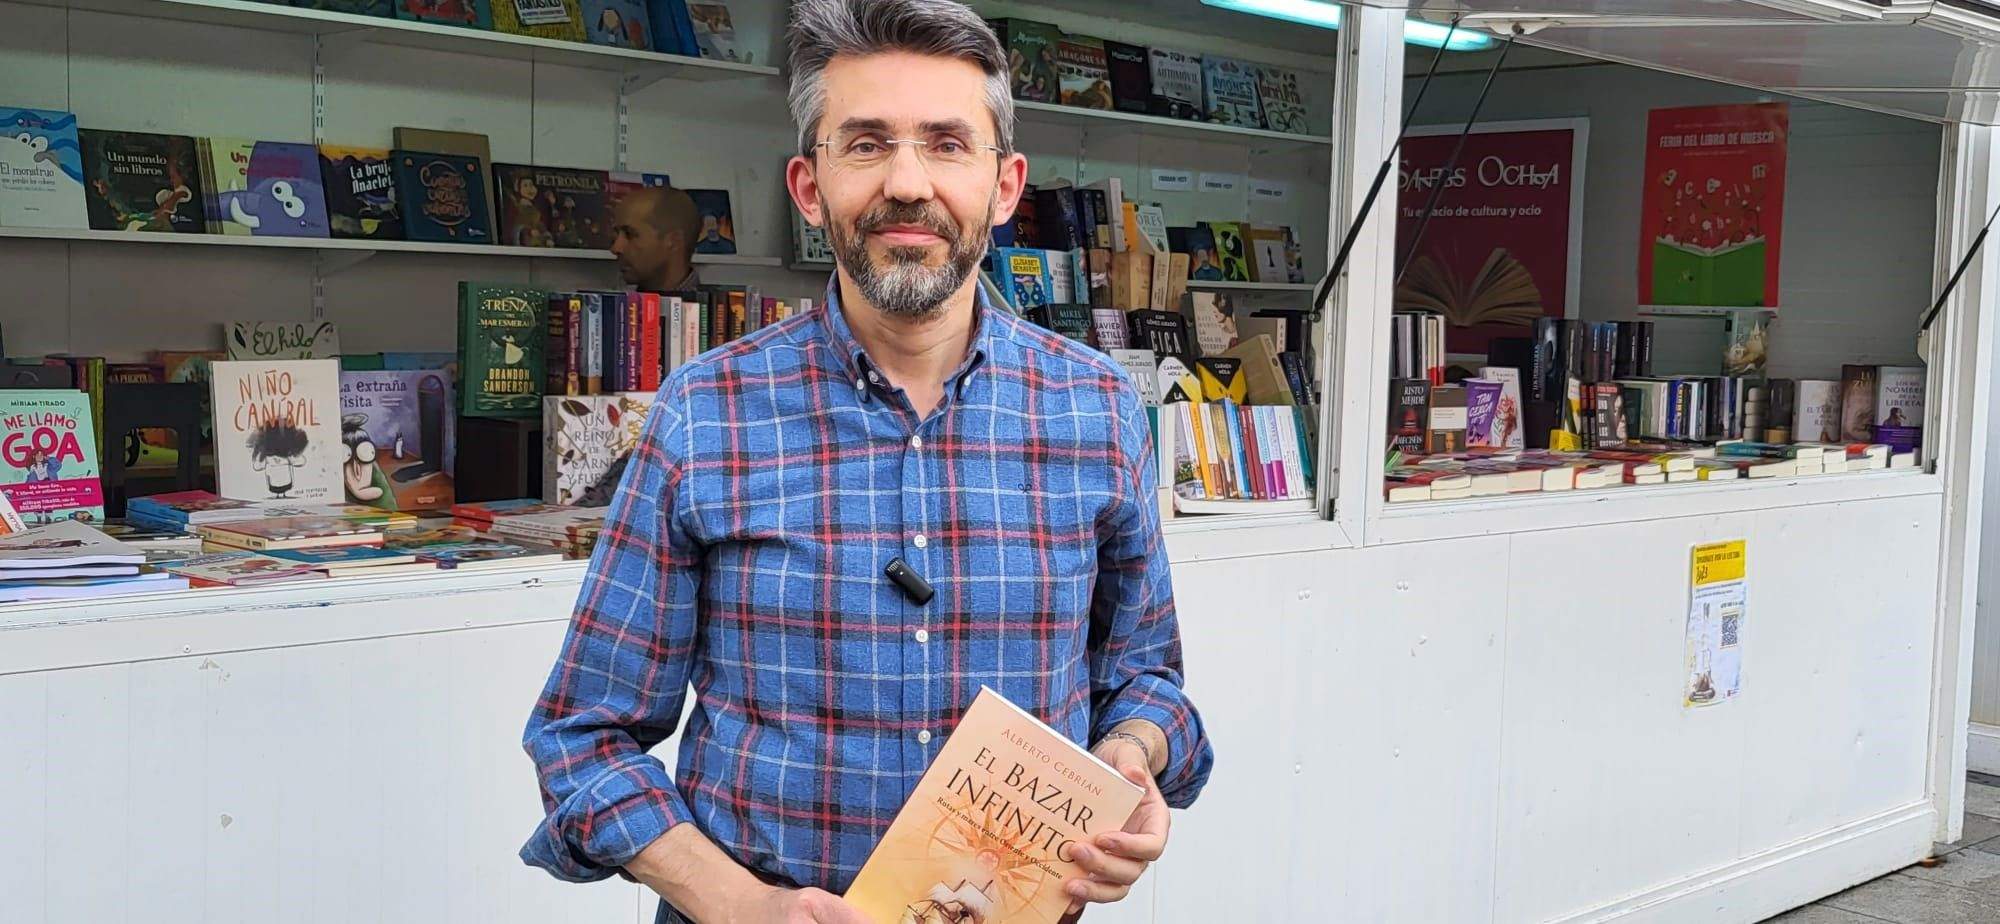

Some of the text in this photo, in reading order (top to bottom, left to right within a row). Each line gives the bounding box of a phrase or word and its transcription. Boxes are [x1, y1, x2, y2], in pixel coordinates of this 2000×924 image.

[1660, 130, 1775, 148] FERIA DEL LIBRO DE HUESCA
[107, 151, 167, 164] Un mundo
[230, 151, 248, 163] Un
[13, 165, 54, 177] monstruo
[113, 164, 163, 176] sin libros
[350, 166, 363, 178] La
[352, 175, 394, 194] Anaclet
[1403, 207, 1414, 217] Tu
[1455, 205, 1469, 216] de
[1471, 204, 1507, 216] cultura
[1509, 208, 1517, 218] y
[1518, 204, 1541, 216] ocio
[1013, 258, 1038, 266] ELISABET
[1013, 265, 1040, 273] BENAVENT
[480, 318, 498, 328] MAR
[1052, 319, 1091, 328] SANTIAGO
[253, 329, 279, 356] El
[1150, 330, 1182, 354] CICA
[489, 367, 530, 380] BRANDON
[239, 369, 293, 402] NIÑO
[356, 380, 408, 393] extraña
[483, 380, 536, 393] SANDERSON
[1404, 385, 1424, 396] RISTO
[1174, 392, 1183, 400] LA
[1400, 395, 1425, 406] MEJIDE
[1885, 399, 1920, 407] LIBERTA
[233, 397, 321, 432] CANÍBAL
[1469, 402, 1493, 418] CERCA
[4, 411, 77, 431] ME LLAMO
[585, 416, 604, 427] UN
[575, 430, 615, 442] REINO
[2, 426, 85, 468] GOA
[566, 473, 575, 485] Y
[1001, 728, 1102, 797] ALBERTO CEBRIÁN
[973, 746, 1094, 835] EL BAZAR
[937, 796, 956, 814] Rutas
[961, 814, 981, 830] mares
[981, 828, 1000, 841] entre
[1030, 856, 1063, 880] Occidente
